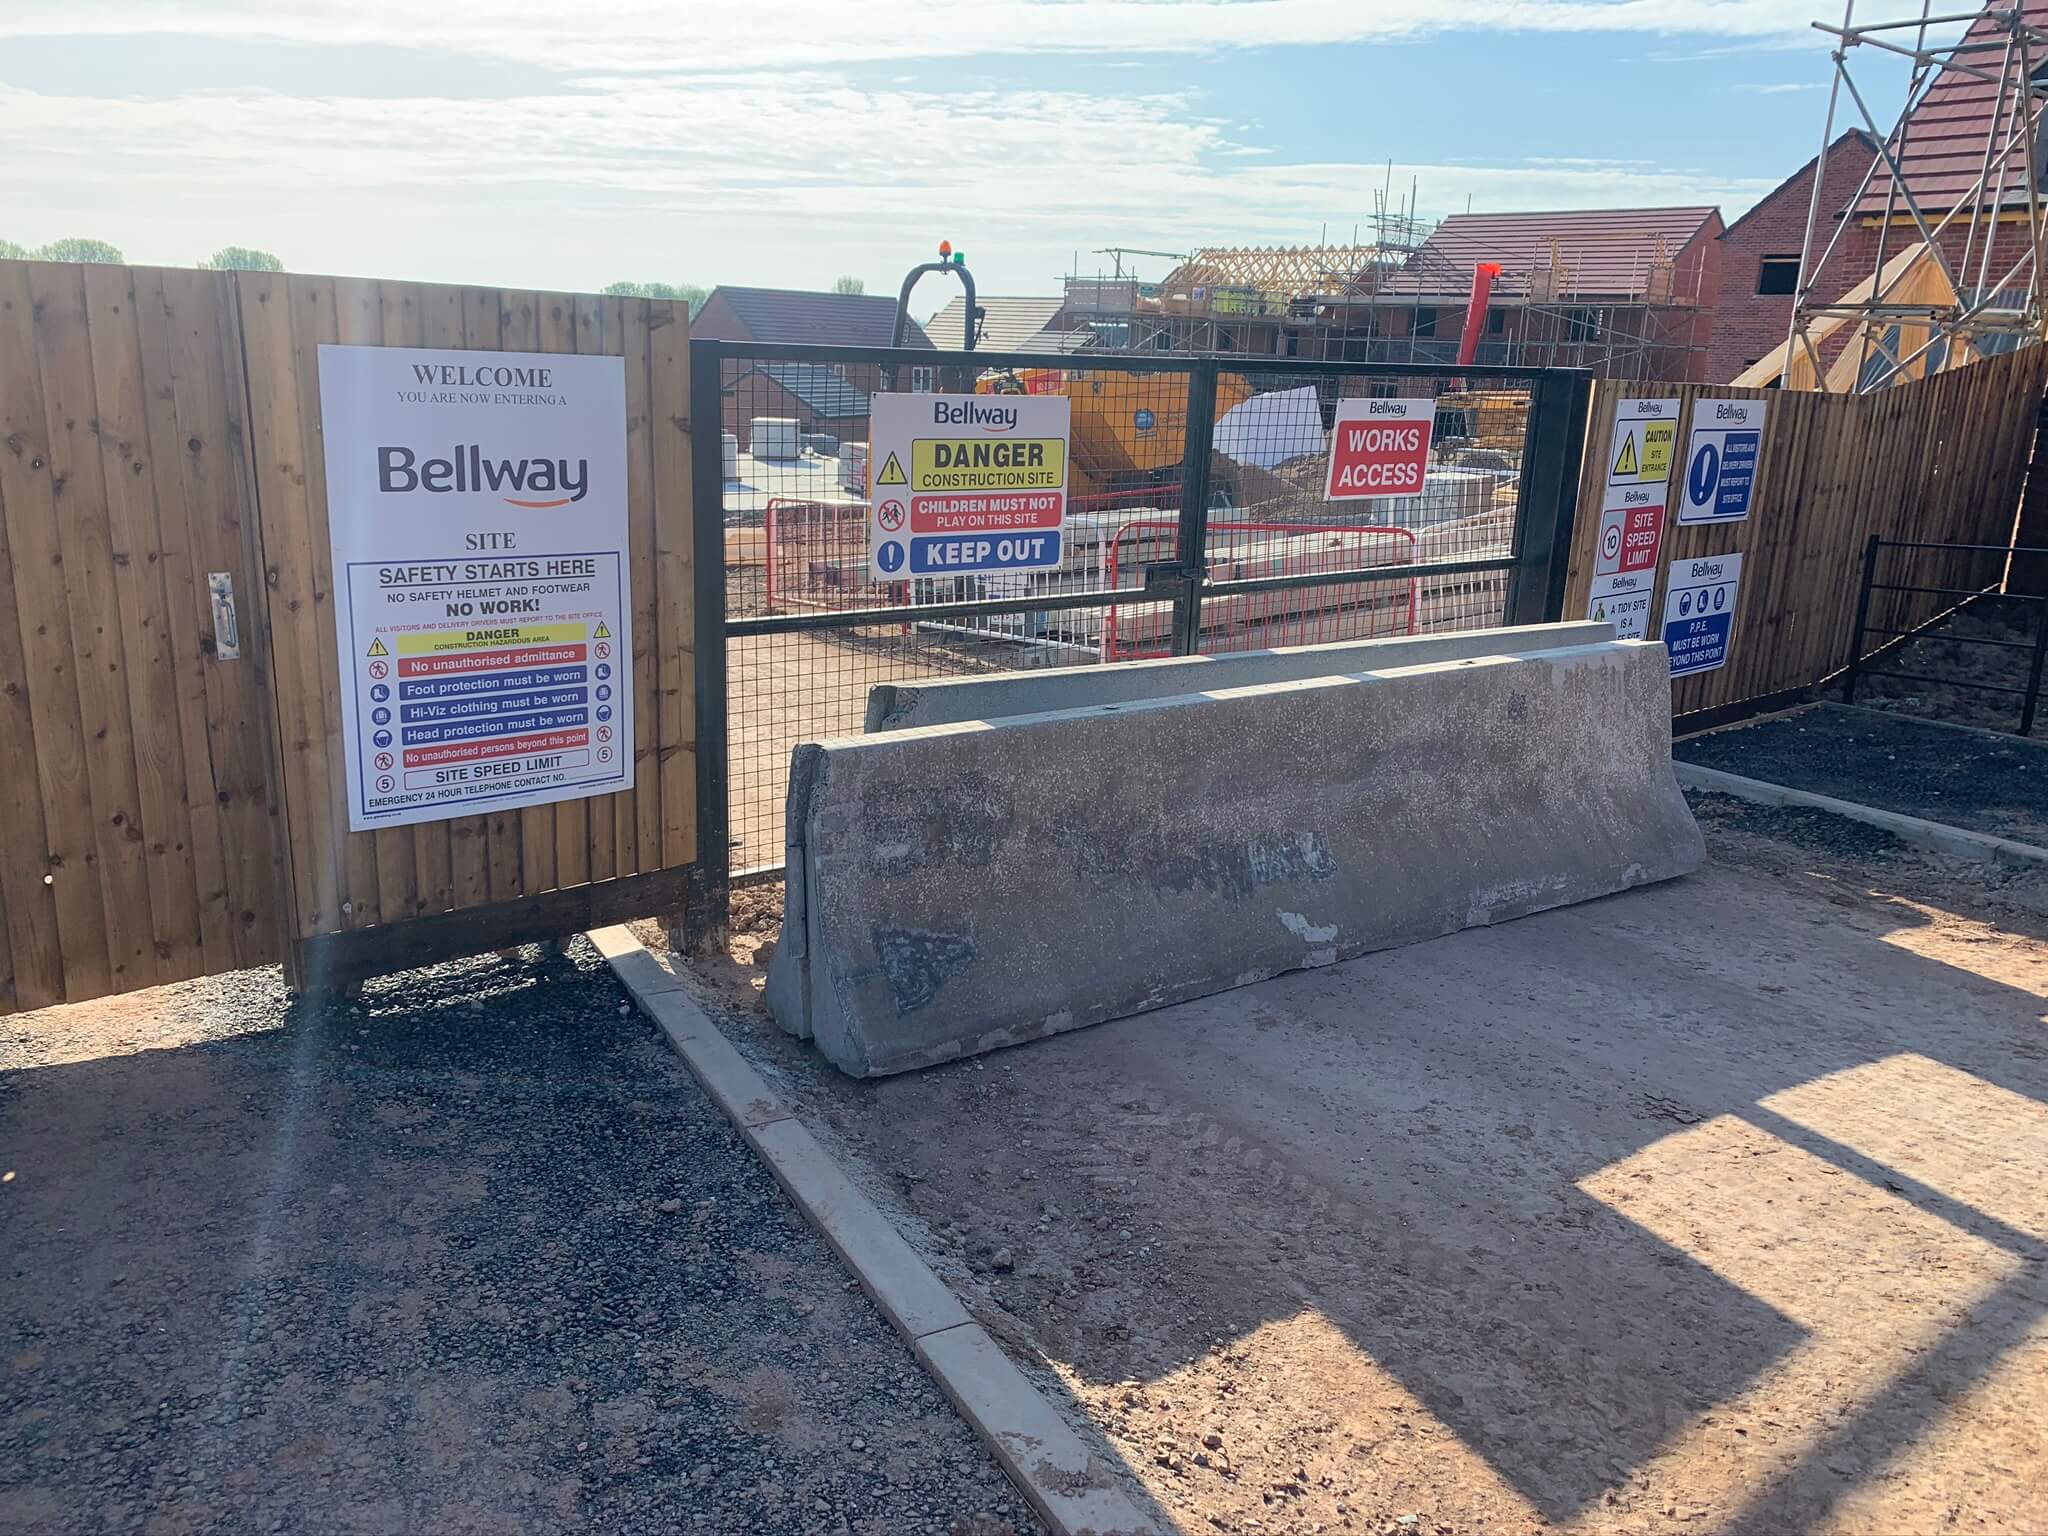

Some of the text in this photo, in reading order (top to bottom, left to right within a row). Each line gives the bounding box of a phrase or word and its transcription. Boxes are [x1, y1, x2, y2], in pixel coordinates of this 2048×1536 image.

[412, 364, 552, 388] WELCOME
[397, 391, 567, 406] YOU ARE NOW ENTERING A
[934, 401, 1017, 430] Bellway
[1369, 401, 1407, 416] Bellway
[1638, 402, 1663, 414] Bellway
[1716, 404, 1748, 423] Bellway
[1348, 428, 1420, 452] WORKS
[1645, 430, 1673, 443] CAUTION
[935, 443, 1044, 468] DANGER
[1651, 450, 1662, 459] SITE
[377, 444, 588, 502] Bellway
[1338, 462, 1418, 487] ACCESS
[1641, 463, 1667, 473] ENTRANCE
[922, 472, 1054, 487] CONSTRUCTION SITE
[919, 497, 1056, 514] CHILDREN MUST NOT
[1624, 491, 1650, 503] Bellway
[937, 513, 1038, 527] PLAY ON THIS SITE
[1633, 512, 1654, 528] SITE
[465, 532, 517, 550] SITE
[1607, 535, 1617, 549] 10
[1627, 530, 1656, 548] SPEED
[927, 538, 1045, 565] KEEP OUT
[1627, 549, 1651, 566] LIMIT
[379, 559, 595, 584] SAFETY STARTS HERE
[1692, 562, 1724, 578] Bellway
[1612, 578, 1637, 590] Bellway
[387, 583, 590, 603] NO SAFETY HELMET AND FOOTWEAR
[446, 599, 540, 617] NO WORK!
[1610, 599, 1647, 615] A TIDY SITE
[389, 624, 420, 632] VISITORS
[438, 621, 469, 629] DELIVERY
[1620, 617, 1633, 629] IS A
[466, 628, 519, 641] DANGER
[434, 640, 488, 650] CONSTRUCTION
[490, 637, 531, 646] HAZARDOUS
[1672, 638, 1691, 652] MUST
[1691, 636, 1700, 648] BE
[411, 650, 575, 673] No unauthorised admittance
[1668, 646, 1723, 667] EYOND THIS POINT
[407, 671, 581, 696] Foot protection must be worn
[450, 701, 498, 714] clothing
[502, 696, 530, 709] must
[534, 694, 548, 705] be
[552, 692, 579, 703] worn
[407, 713, 584, 741] Head protection must be worn
[406, 733, 586, 763] No unauthorised persons beyond this point
[601, 750, 609, 759] 5
[435, 755, 562, 783] SITE SPEED LIMIT
[369, 792, 423, 808] EMERGENCY
[426, 792, 435, 800] 24
[438, 787, 463, 798] HOUR
[465, 781, 511, 795] TELEPHONE
[514, 775, 550, 788] CONTACT
[381, 778, 390, 790] 5
